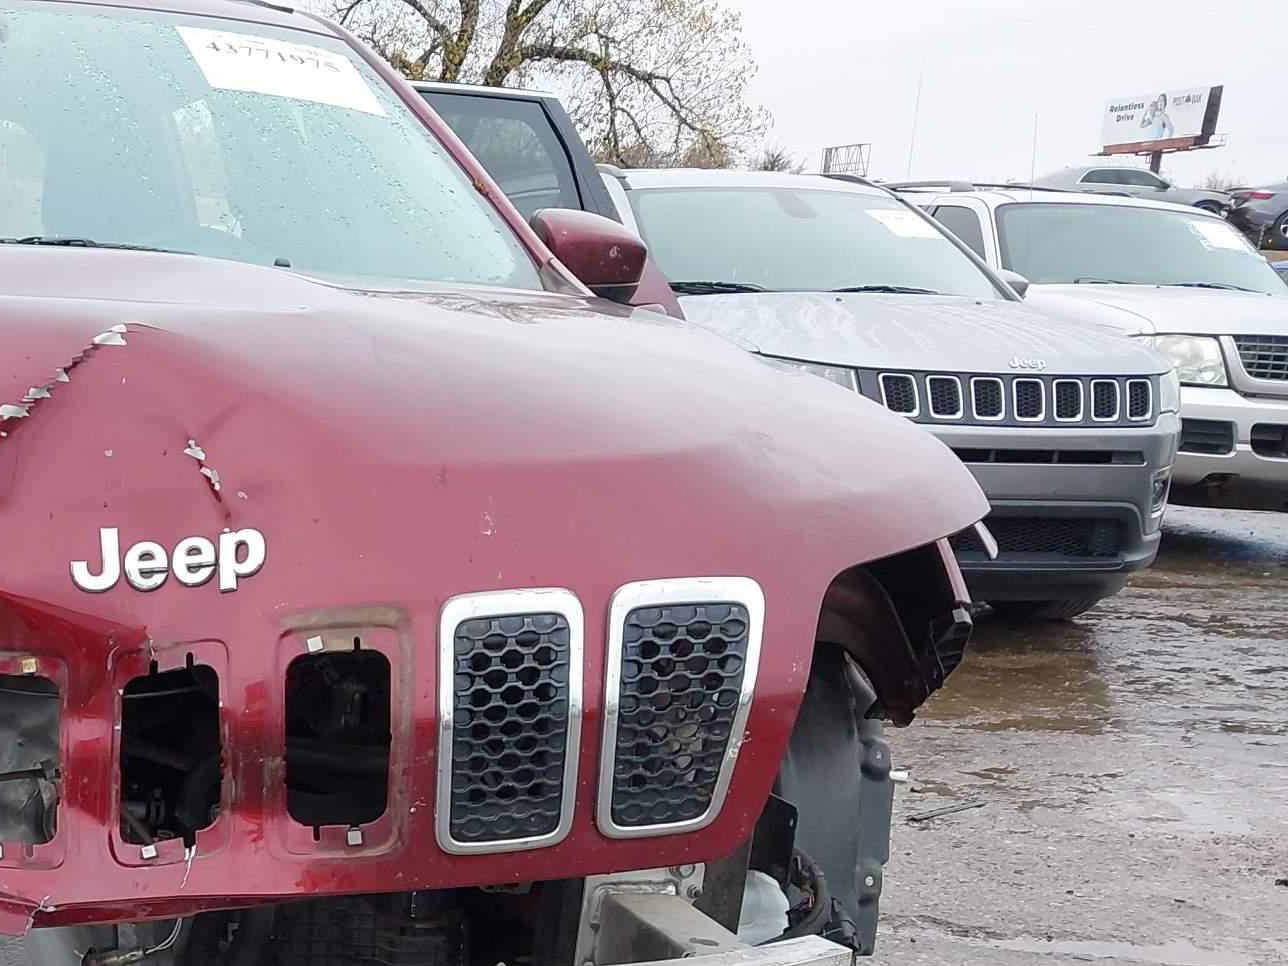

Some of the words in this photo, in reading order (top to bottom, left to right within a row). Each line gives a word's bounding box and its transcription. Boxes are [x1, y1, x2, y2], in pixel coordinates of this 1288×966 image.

[206, 40, 341, 73] 43771975
[1109, 102, 1145, 113] Relentless
[1116, 114, 1134, 122] Drive
[1008, 356, 1047, 371] Jeep
[69, 526, 266, 593] Jeep
